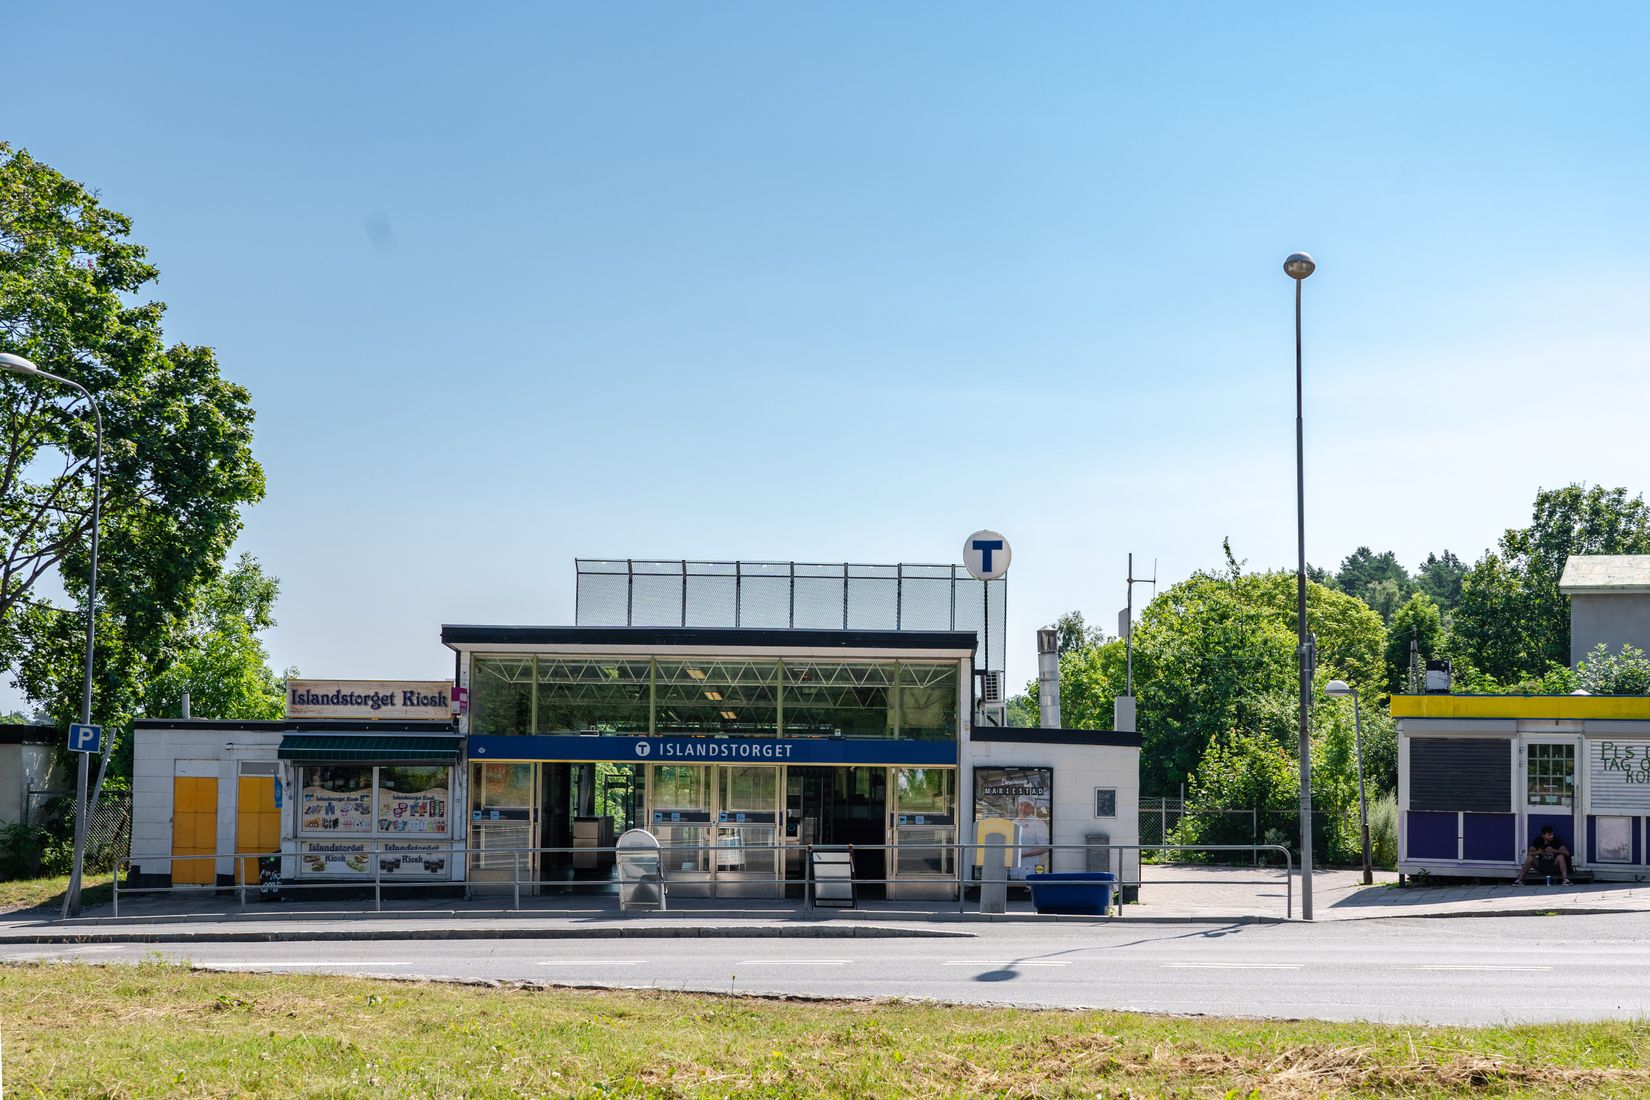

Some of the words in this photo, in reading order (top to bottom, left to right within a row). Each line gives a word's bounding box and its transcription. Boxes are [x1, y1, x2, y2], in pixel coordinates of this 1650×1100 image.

[972, 540, 1003, 572] T
[290, 688, 396, 711] Islandstorget
[401, 689, 449, 708] Kiosk
[78, 727, 94, 749] P
[659, 743, 793, 757] ISLANDSTORGET
[1601, 741, 1635, 759] PLS
[1600, 758, 1632, 771] TAG
[984, 787, 1044, 795] MARIESTAD
[402, 855, 424, 863] Kiosk
